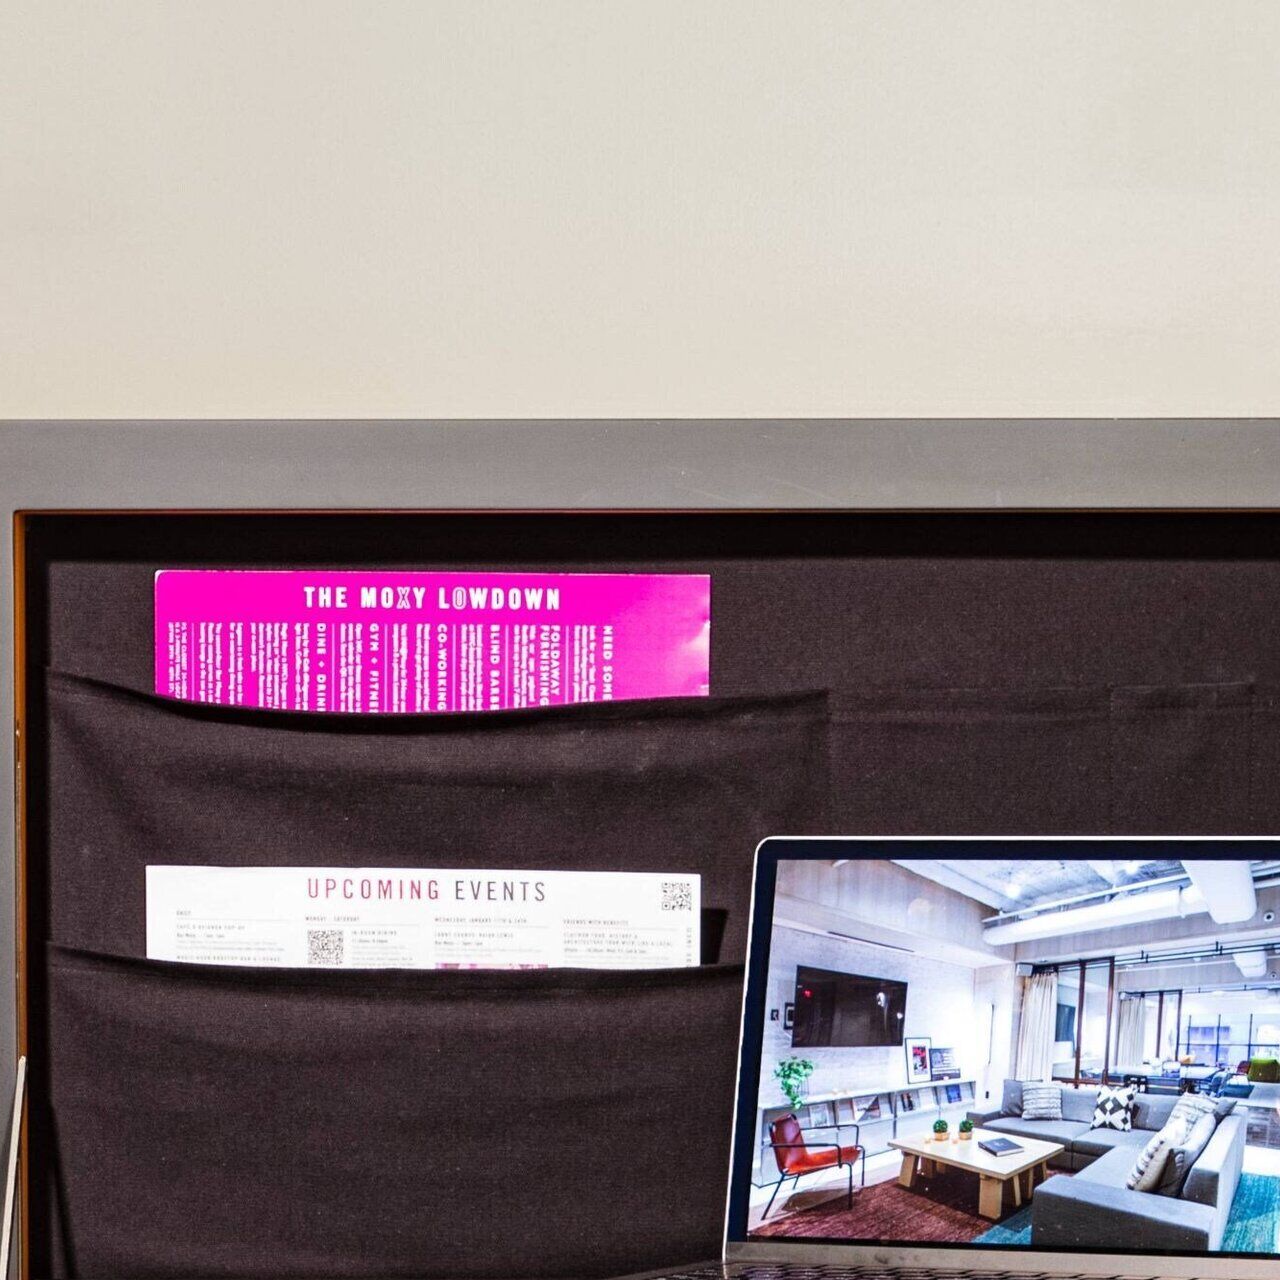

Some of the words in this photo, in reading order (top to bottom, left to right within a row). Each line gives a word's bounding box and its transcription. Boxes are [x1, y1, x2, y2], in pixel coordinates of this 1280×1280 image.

[303, 586, 347, 609] THE
[360, 586, 426, 610] MOXY
[438, 587, 560, 611] LOWDOWN
[316, 622, 326, 655] DINE
[369, 622, 379, 651] GYM
[490, 624, 500, 664] BLIND
[603, 625, 613, 660] NEED
[437, 623, 447, 711] CO-WORKING
[550, 624, 560, 695] FOLDAWAY
[308, 878, 440, 900] UPCOMING
[455, 880, 547, 902] EVENTS
